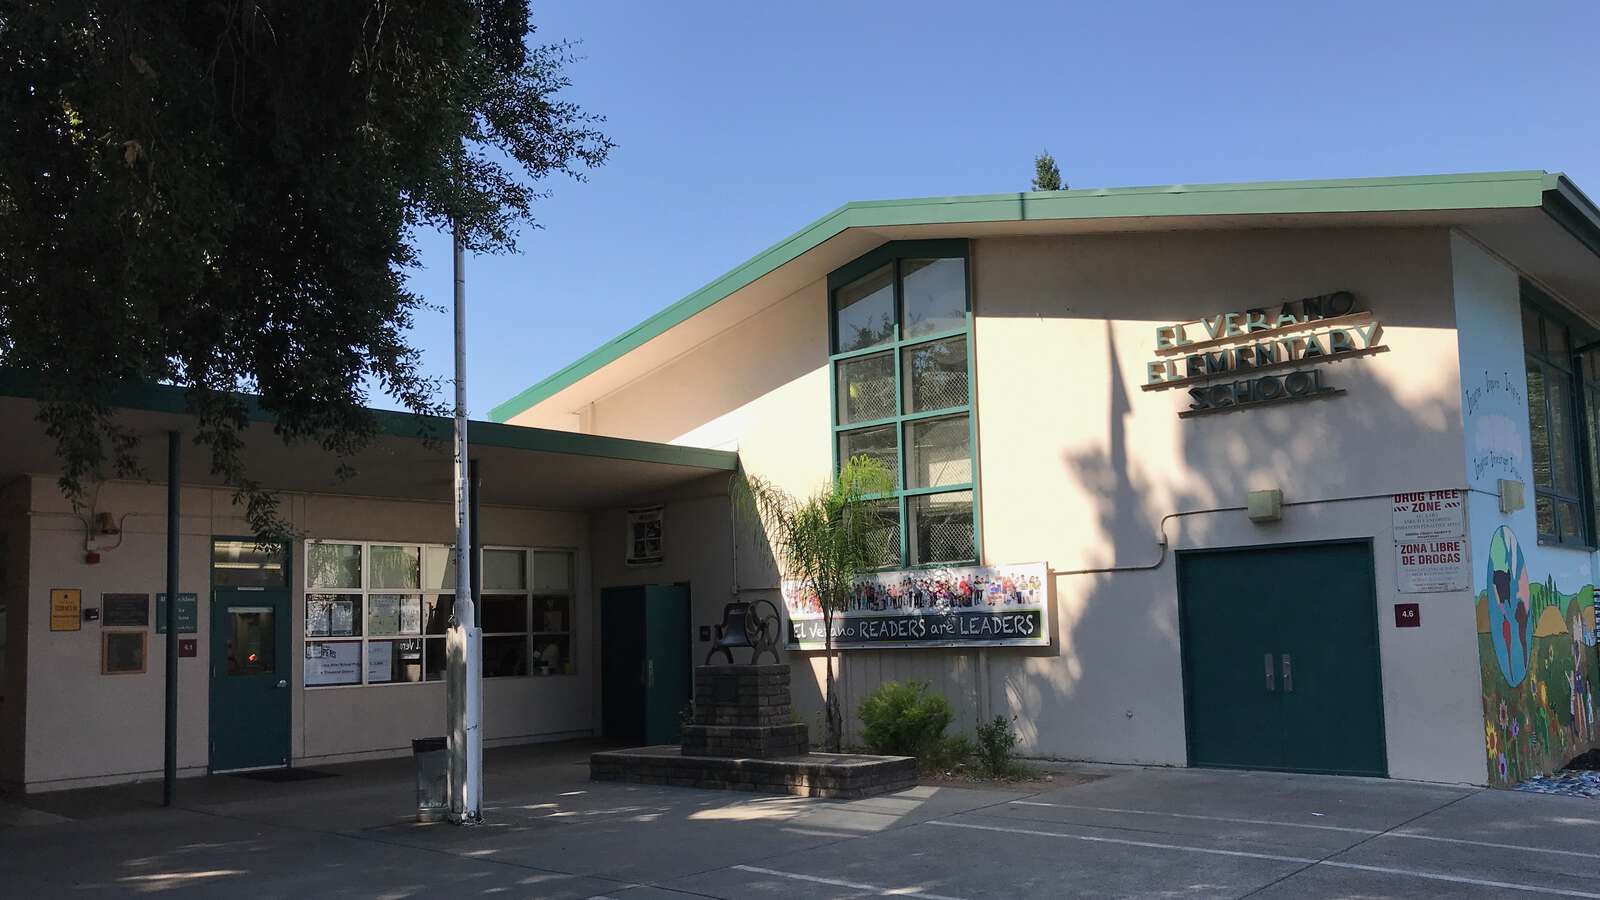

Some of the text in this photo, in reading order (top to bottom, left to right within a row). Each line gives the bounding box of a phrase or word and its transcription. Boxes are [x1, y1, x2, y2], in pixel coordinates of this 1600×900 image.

[1156, 290, 1355, 350] EL VERANO
[1147, 321, 1384, 385] ELEMENTARY
[1188, 369, 1336, 411] SCHOOL
[1394, 489, 1459, 503] DRUG FREE
[1412, 501, 1441, 513] ZONE
[1401, 541, 1460, 555] ZONA LIBRE
[1402, 552, 1461, 566] DE DROGAS
[1401, 610, 1414, 618] 4.6
[793, 614, 1034, 639] El Veano READERS are LEADERS
